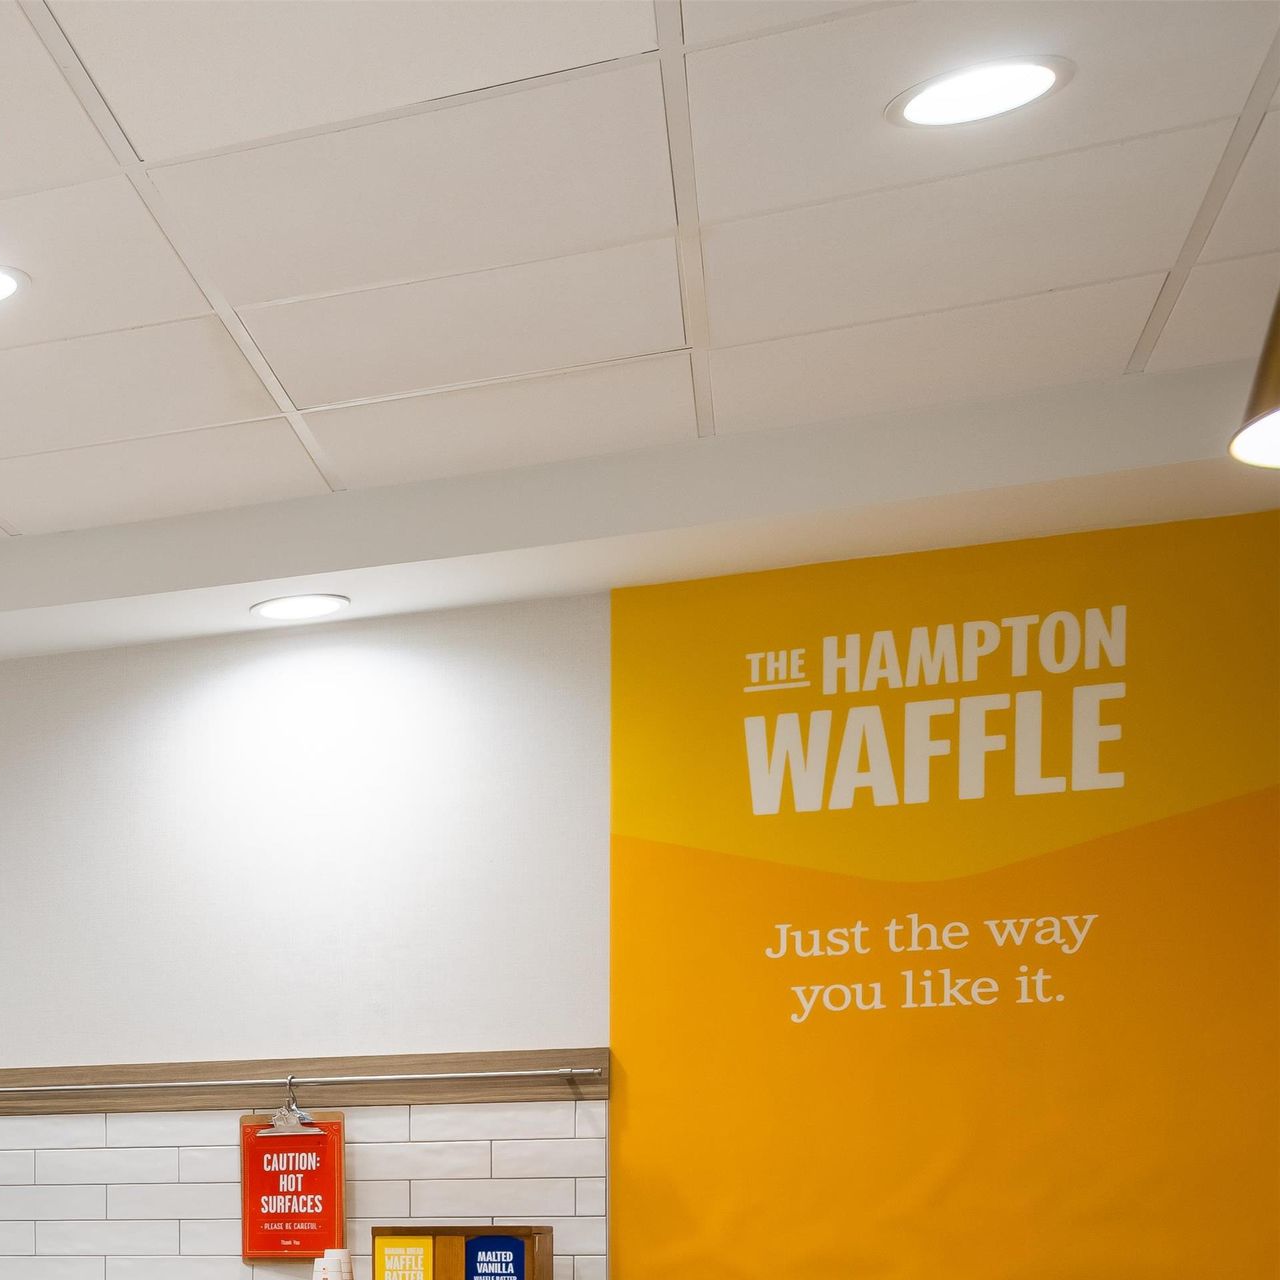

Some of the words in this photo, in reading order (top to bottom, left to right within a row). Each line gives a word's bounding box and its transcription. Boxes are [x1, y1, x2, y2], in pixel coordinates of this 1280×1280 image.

[745, 648, 806, 683] THE
[822, 605, 1128, 695] HAMPTON
[743, 681, 1127, 816] WAFFLE
[765, 919, 871, 959] Just
[885, 913, 970, 953] the
[984, 914, 1099, 954] way
[790, 978, 886, 1023] you
[900, 968, 1000, 1009] like
[1015, 964, 1066, 1004] it.
[263, 1152, 320, 1172] CAUTION:
[279, 1174, 304, 1192] HOT
[261, 1195, 323, 1214] SURFACES
[264, 1222, 284, 1230] PLEASE
[285, 1222, 292, 1230] BE
[293, 1222, 317, 1230] CAREFUL
[384, 1255, 425, 1270] WAFFLE
[477, 1251, 514, 1262] MALTED
[476, 1262, 515, 1274] VANILLA
